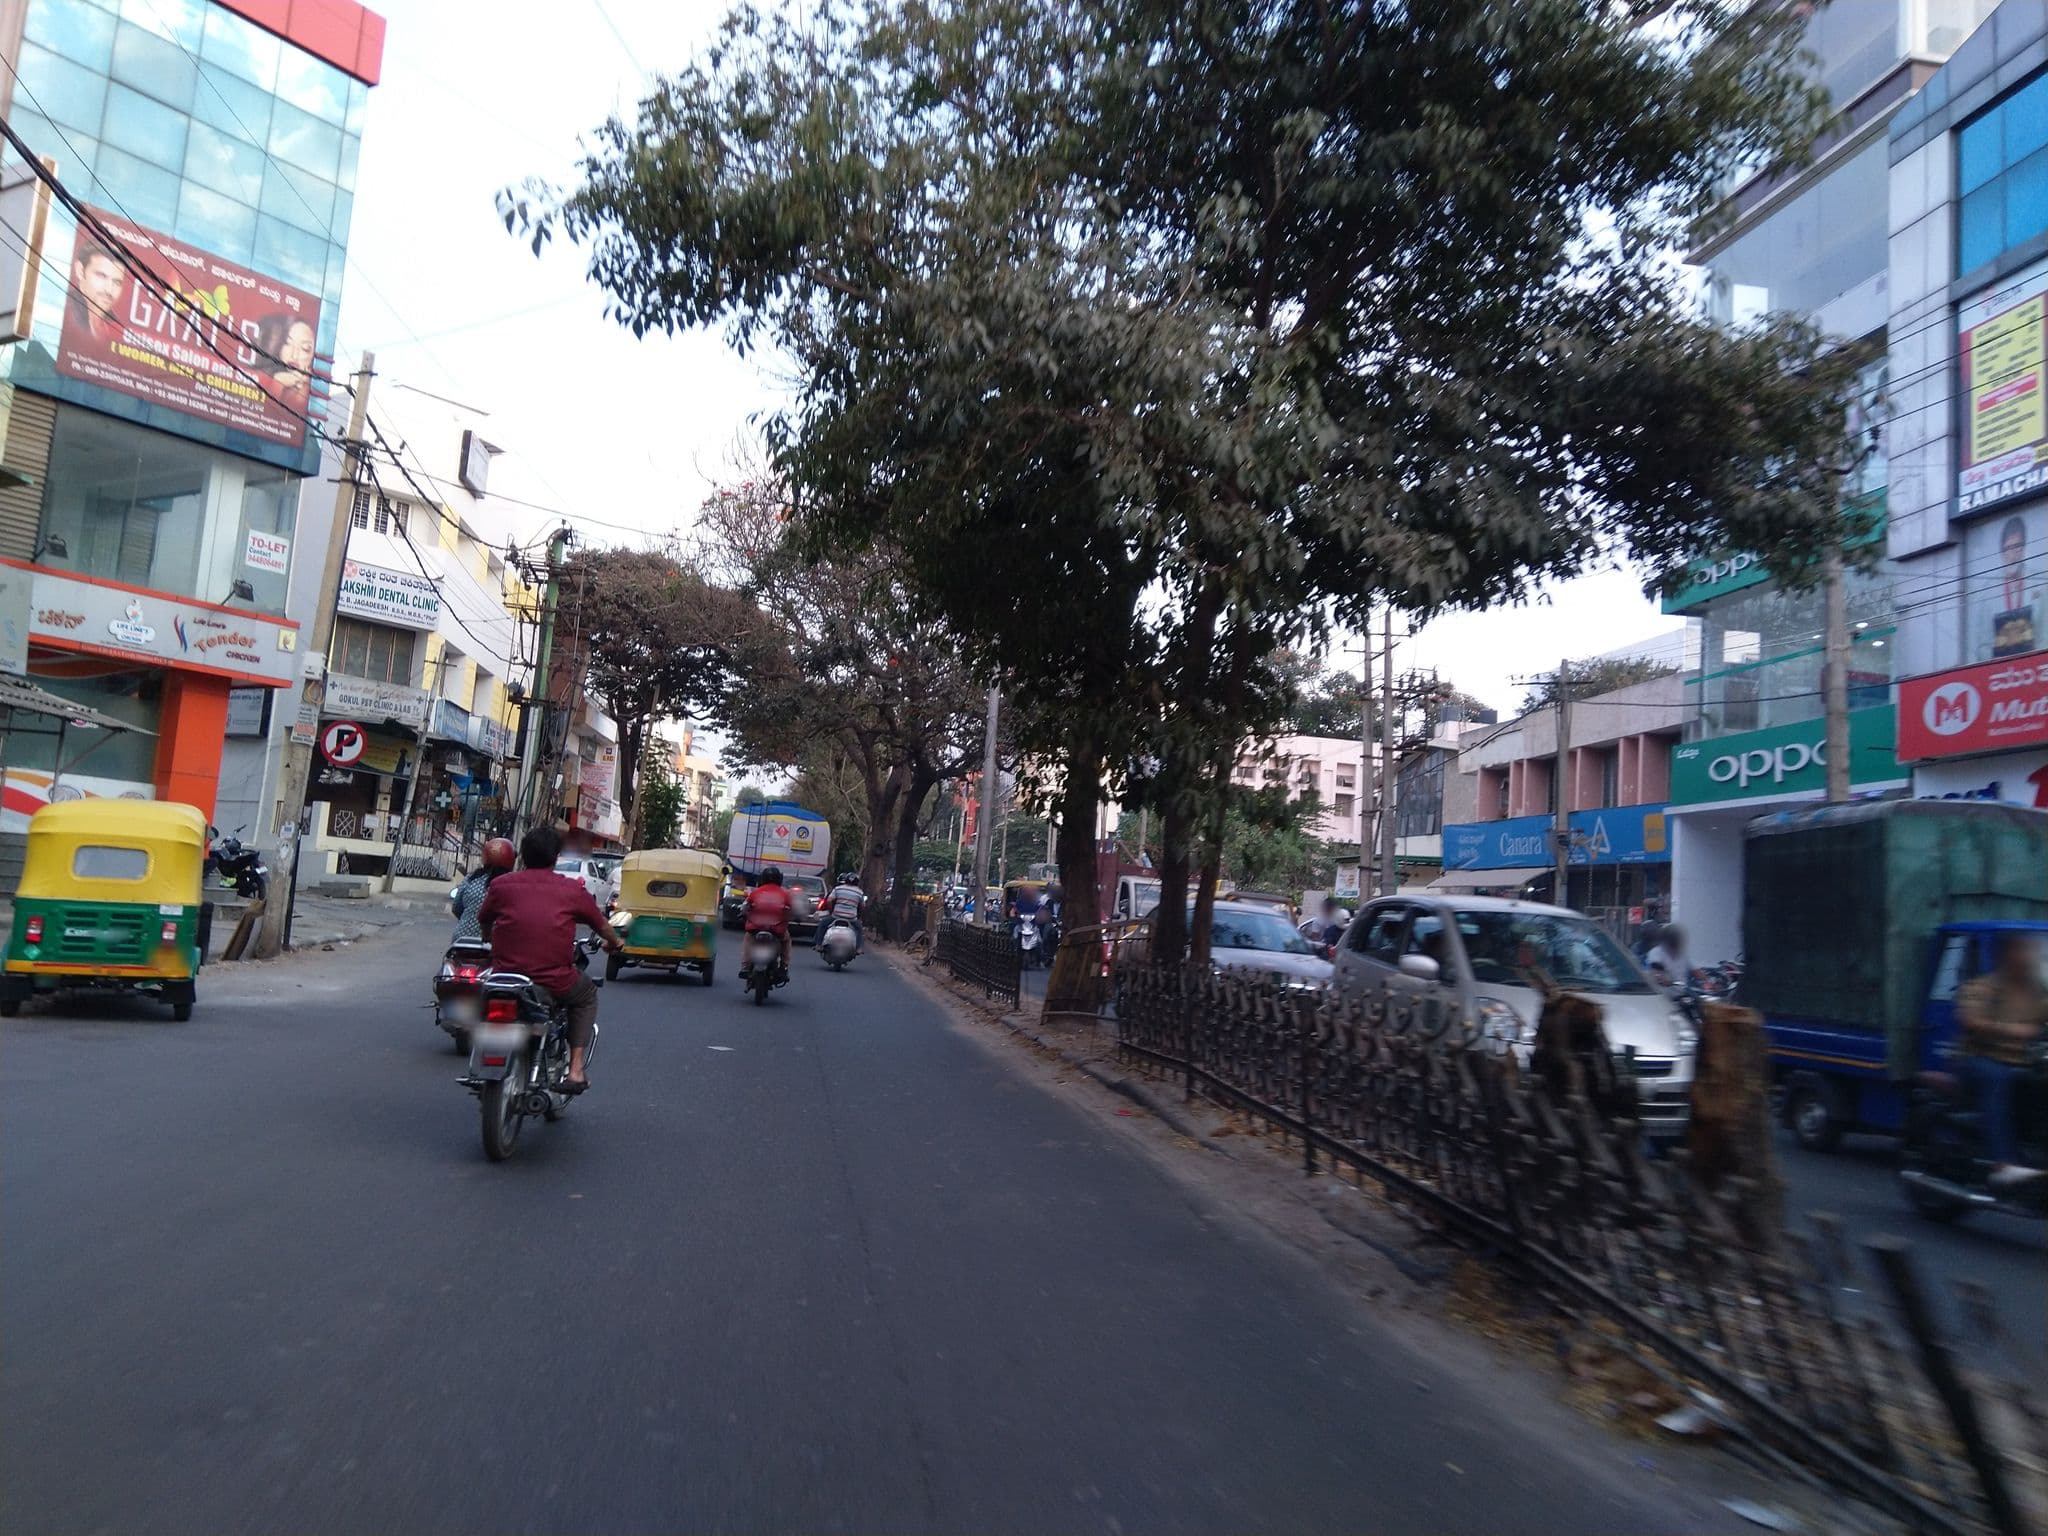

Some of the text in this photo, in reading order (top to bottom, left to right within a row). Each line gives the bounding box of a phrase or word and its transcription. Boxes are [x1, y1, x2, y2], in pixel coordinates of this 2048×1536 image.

[123, 328, 170, 358] Unisex
[172, 343, 210, 371] Salon
[212, 361, 233, 379] and
[169, 361, 194, 379] MEN
[206, 374, 259, 401] CHILDREN
[249, 546, 271, 557] Contact
[250, 536, 287, 554] TO-LET
[353, 599, 389, 612] JAGADEESH
[378, 587, 410, 606] DENTAL
[412, 595, 440, 613] CLINIC
[194, 631, 257, 654] Tender
[226, 650, 261, 664] CHICKEN
[373, 700, 393, 711] CLINIC
[1500, 832, 1543, 857] Canara
